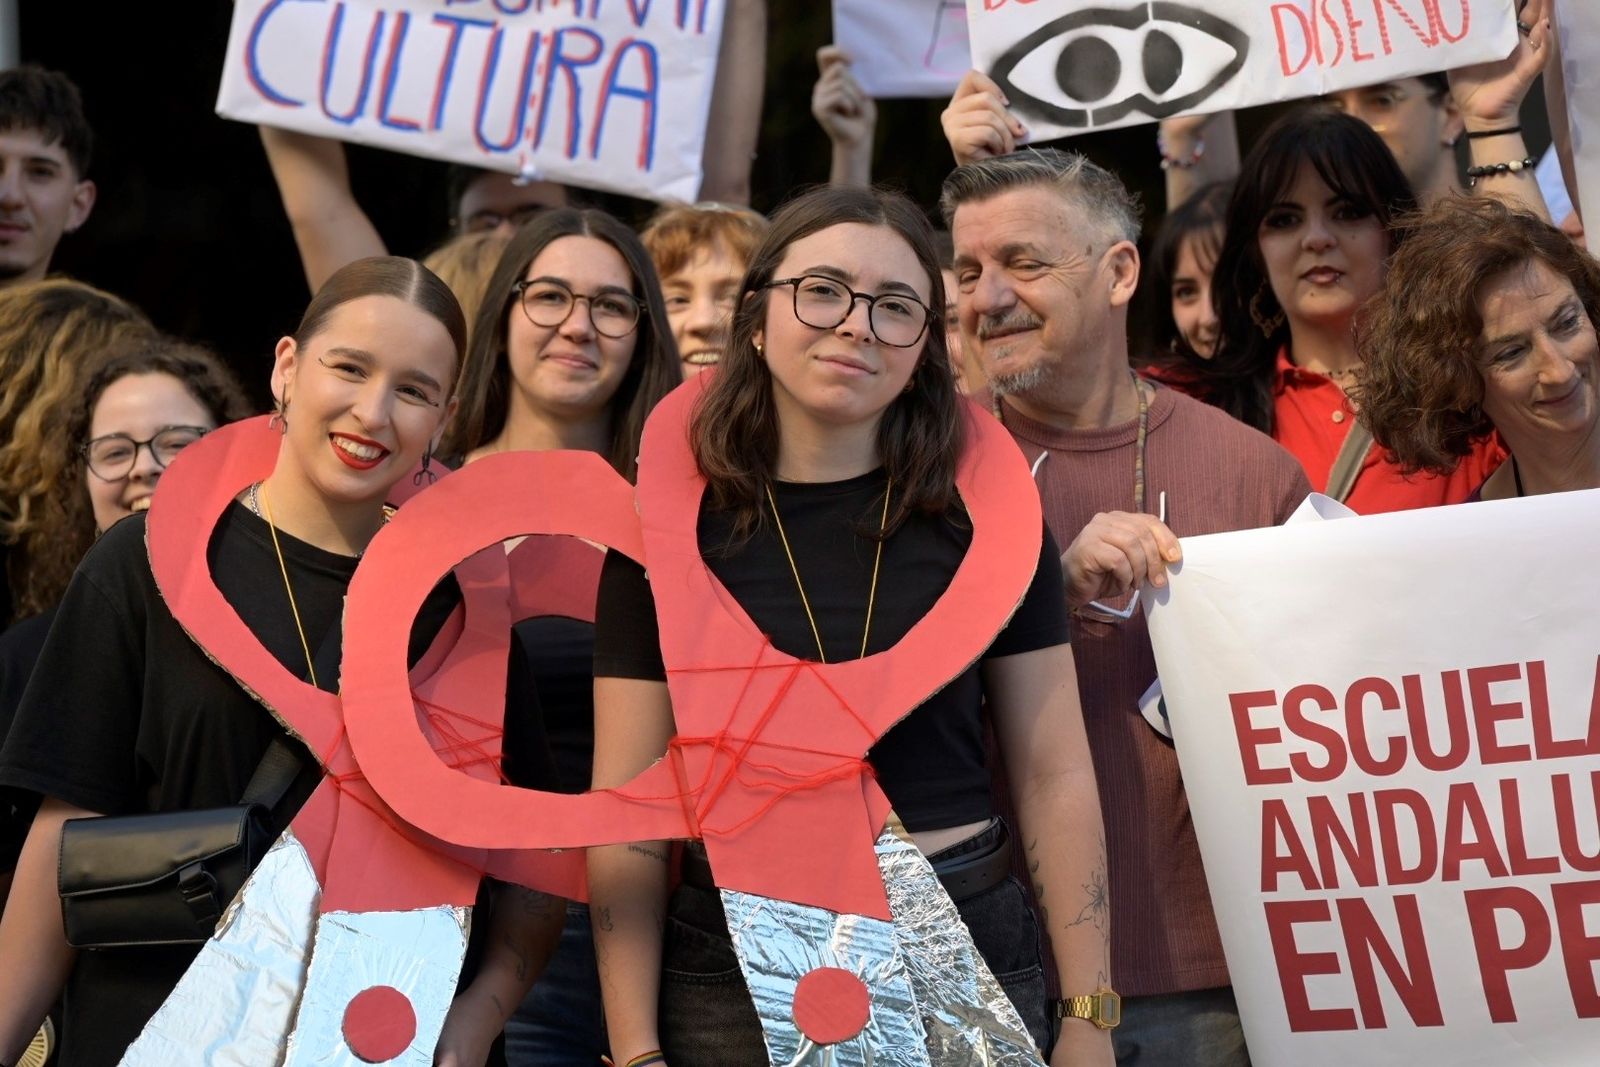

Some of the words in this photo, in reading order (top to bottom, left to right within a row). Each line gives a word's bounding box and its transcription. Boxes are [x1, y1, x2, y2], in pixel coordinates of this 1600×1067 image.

[244, 0, 658, 172] CULTURA
[1228, 655, 1600, 785] ESCUEL
[1261, 771, 1600, 892] ANDALU
[1264, 894, 1445, 1032] EN
[1464, 881, 1600, 1023] PE
